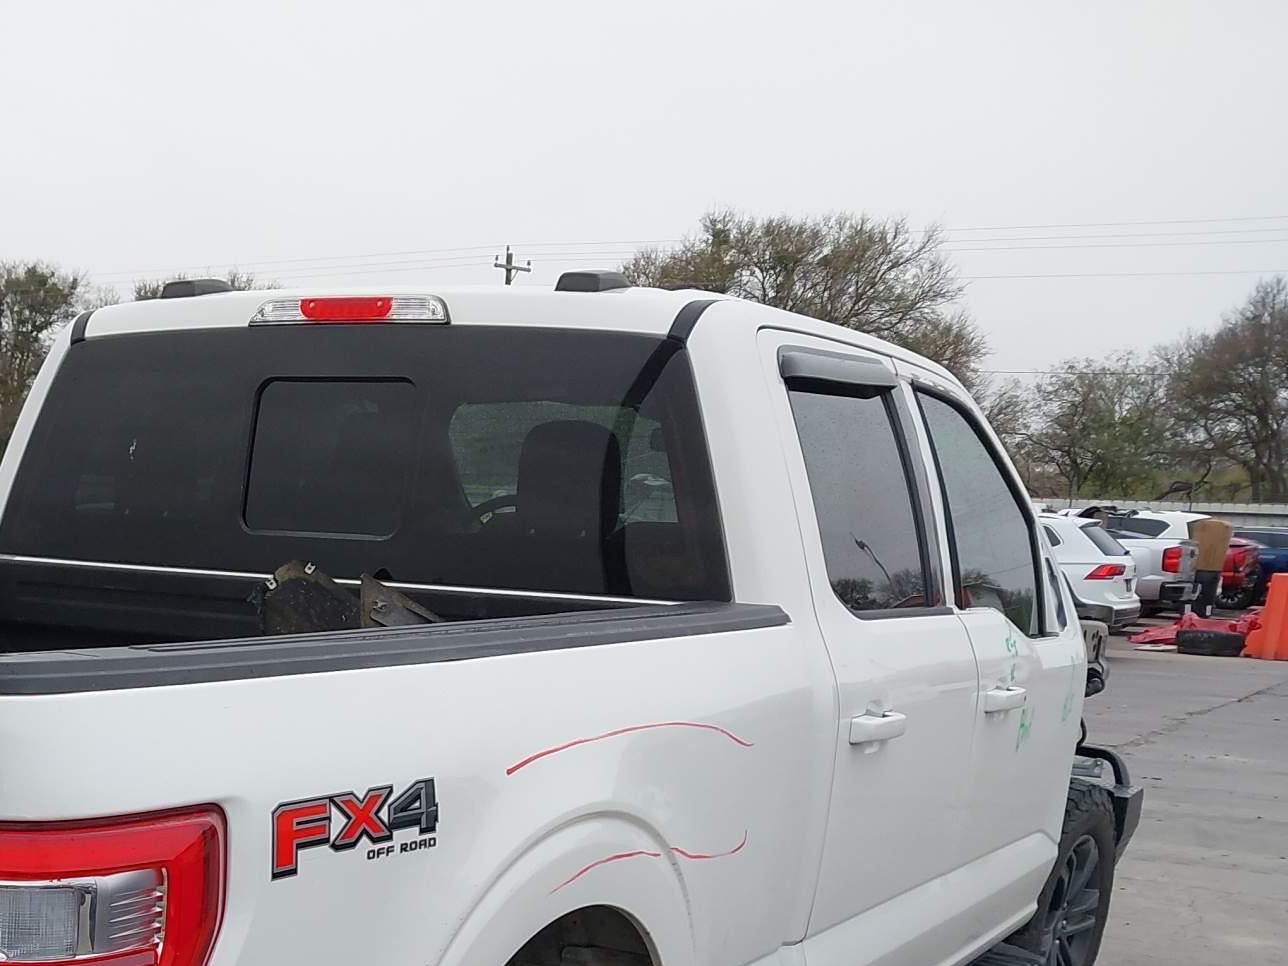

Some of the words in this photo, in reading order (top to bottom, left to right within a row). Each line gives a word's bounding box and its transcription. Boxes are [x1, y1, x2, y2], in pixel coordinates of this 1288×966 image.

[270, 776, 440, 882] FX4
[366, 846, 395, 861] OFF
[399, 836, 438, 854] ROAD
